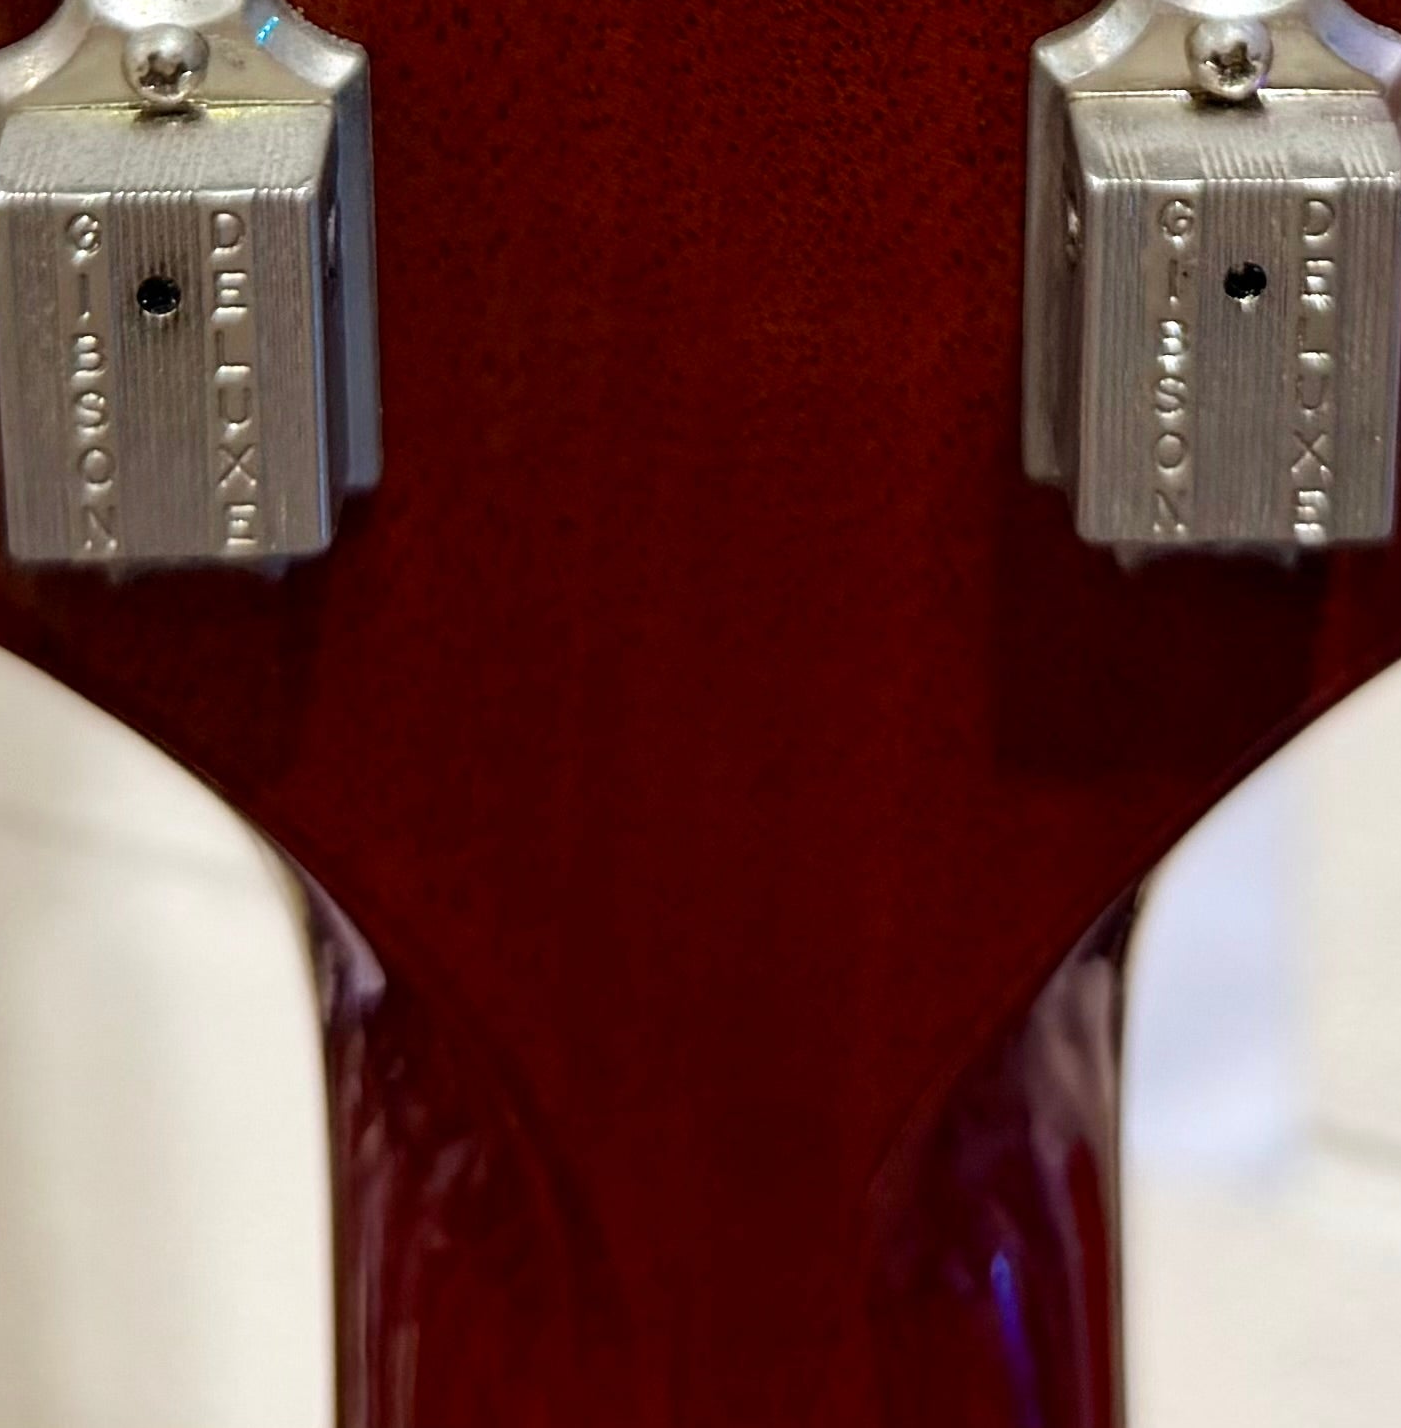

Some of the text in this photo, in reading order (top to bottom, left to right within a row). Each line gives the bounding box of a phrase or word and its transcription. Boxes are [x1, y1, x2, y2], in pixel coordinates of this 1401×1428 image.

[65, 211, 119, 552] GIBSON
[208, 209, 259, 552] DELUXE
[1151, 198, 1197, 536] GIBSON
[1291, 197, 1337, 545] DELUXE
